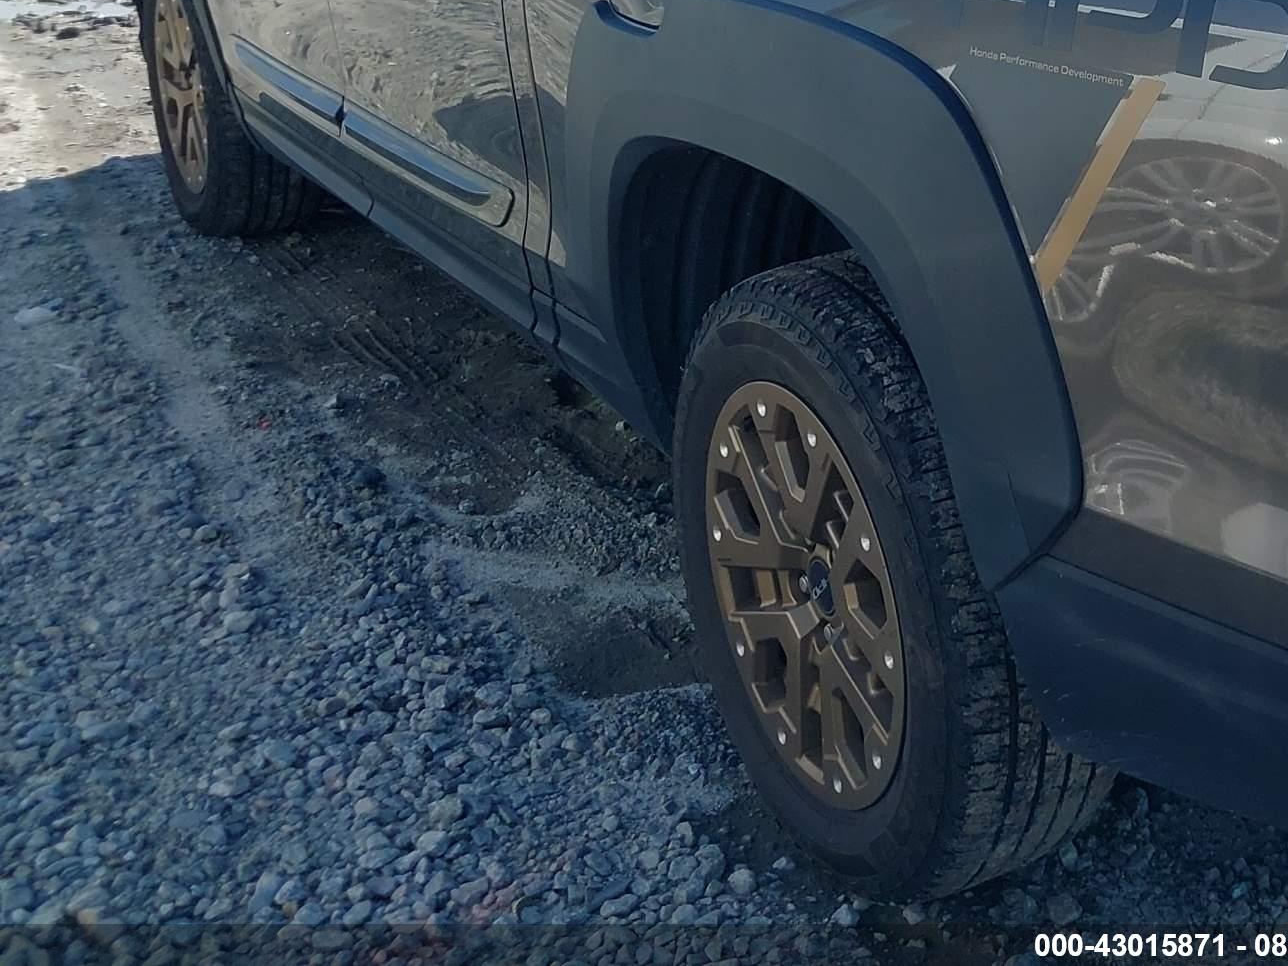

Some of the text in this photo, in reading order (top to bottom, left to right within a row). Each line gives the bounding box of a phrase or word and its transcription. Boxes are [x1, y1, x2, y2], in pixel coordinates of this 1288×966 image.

[969, 46, 1125, 88] Honda Performance Development
